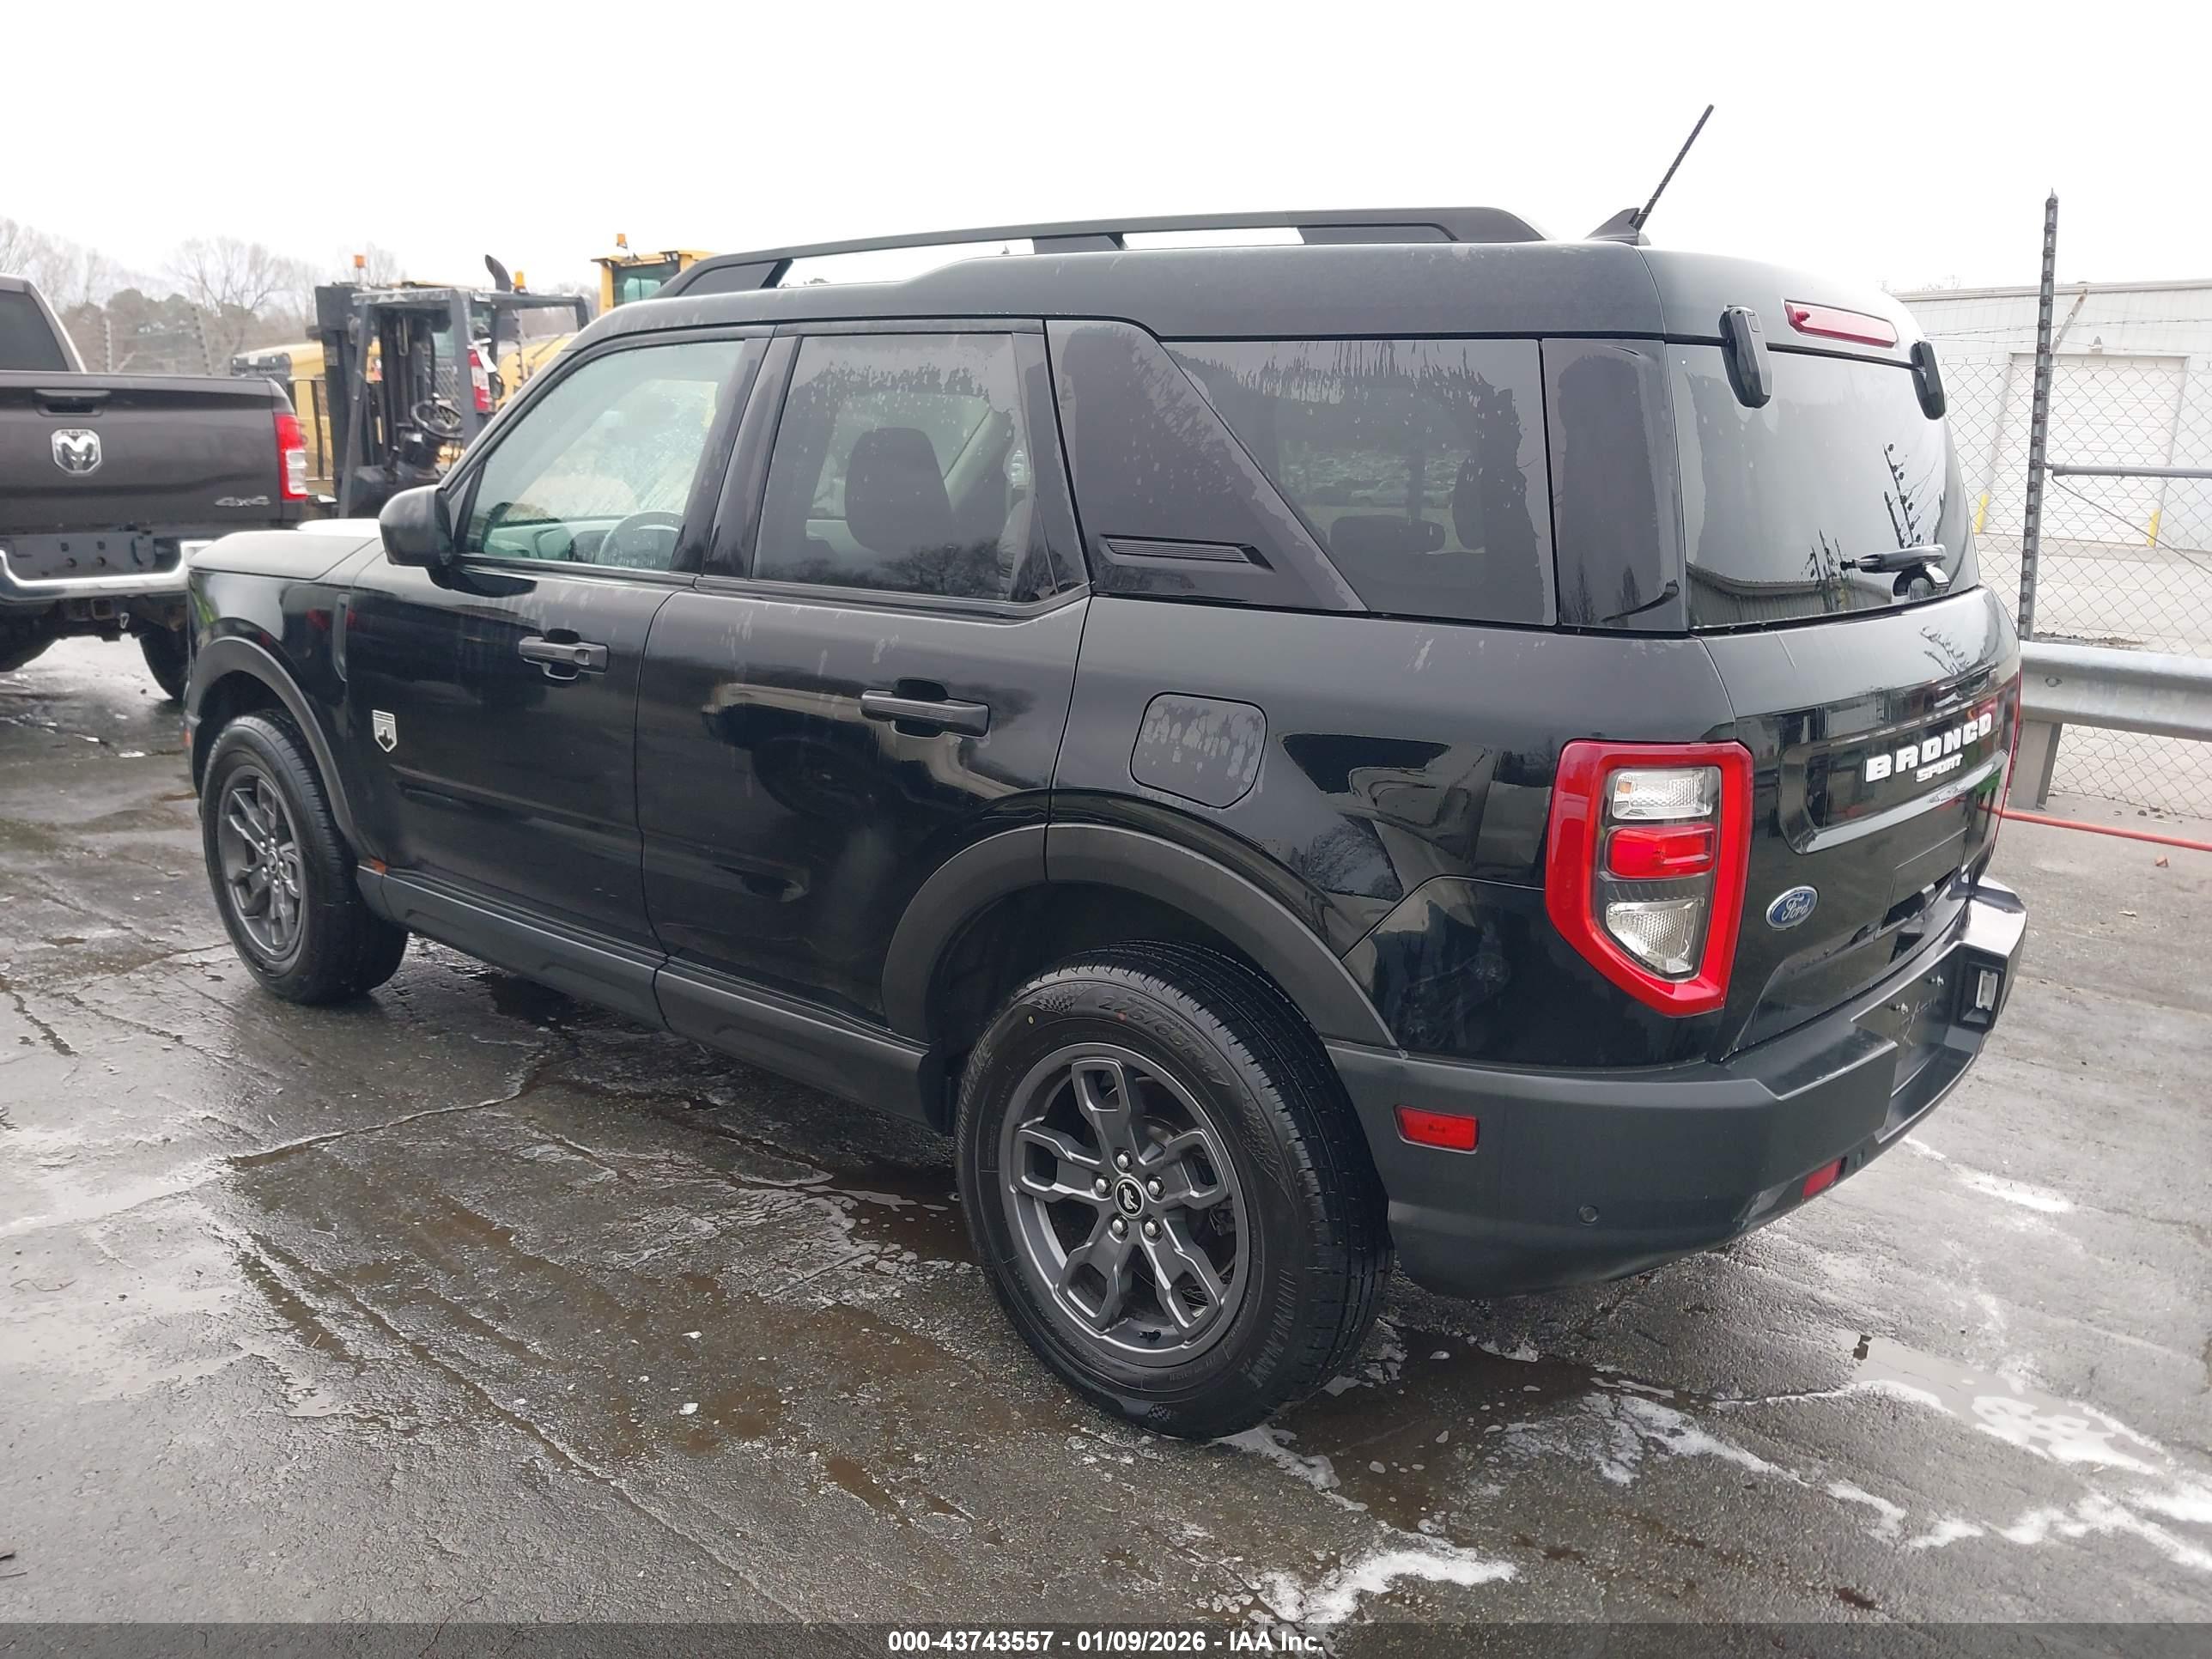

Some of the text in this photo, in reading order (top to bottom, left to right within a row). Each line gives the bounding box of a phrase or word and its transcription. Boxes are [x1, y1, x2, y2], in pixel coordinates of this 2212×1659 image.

[215, 495, 270, 507] 4x4
[1865, 713, 1992, 782] BRONCO
[1916, 753, 1964, 782] SPORT
